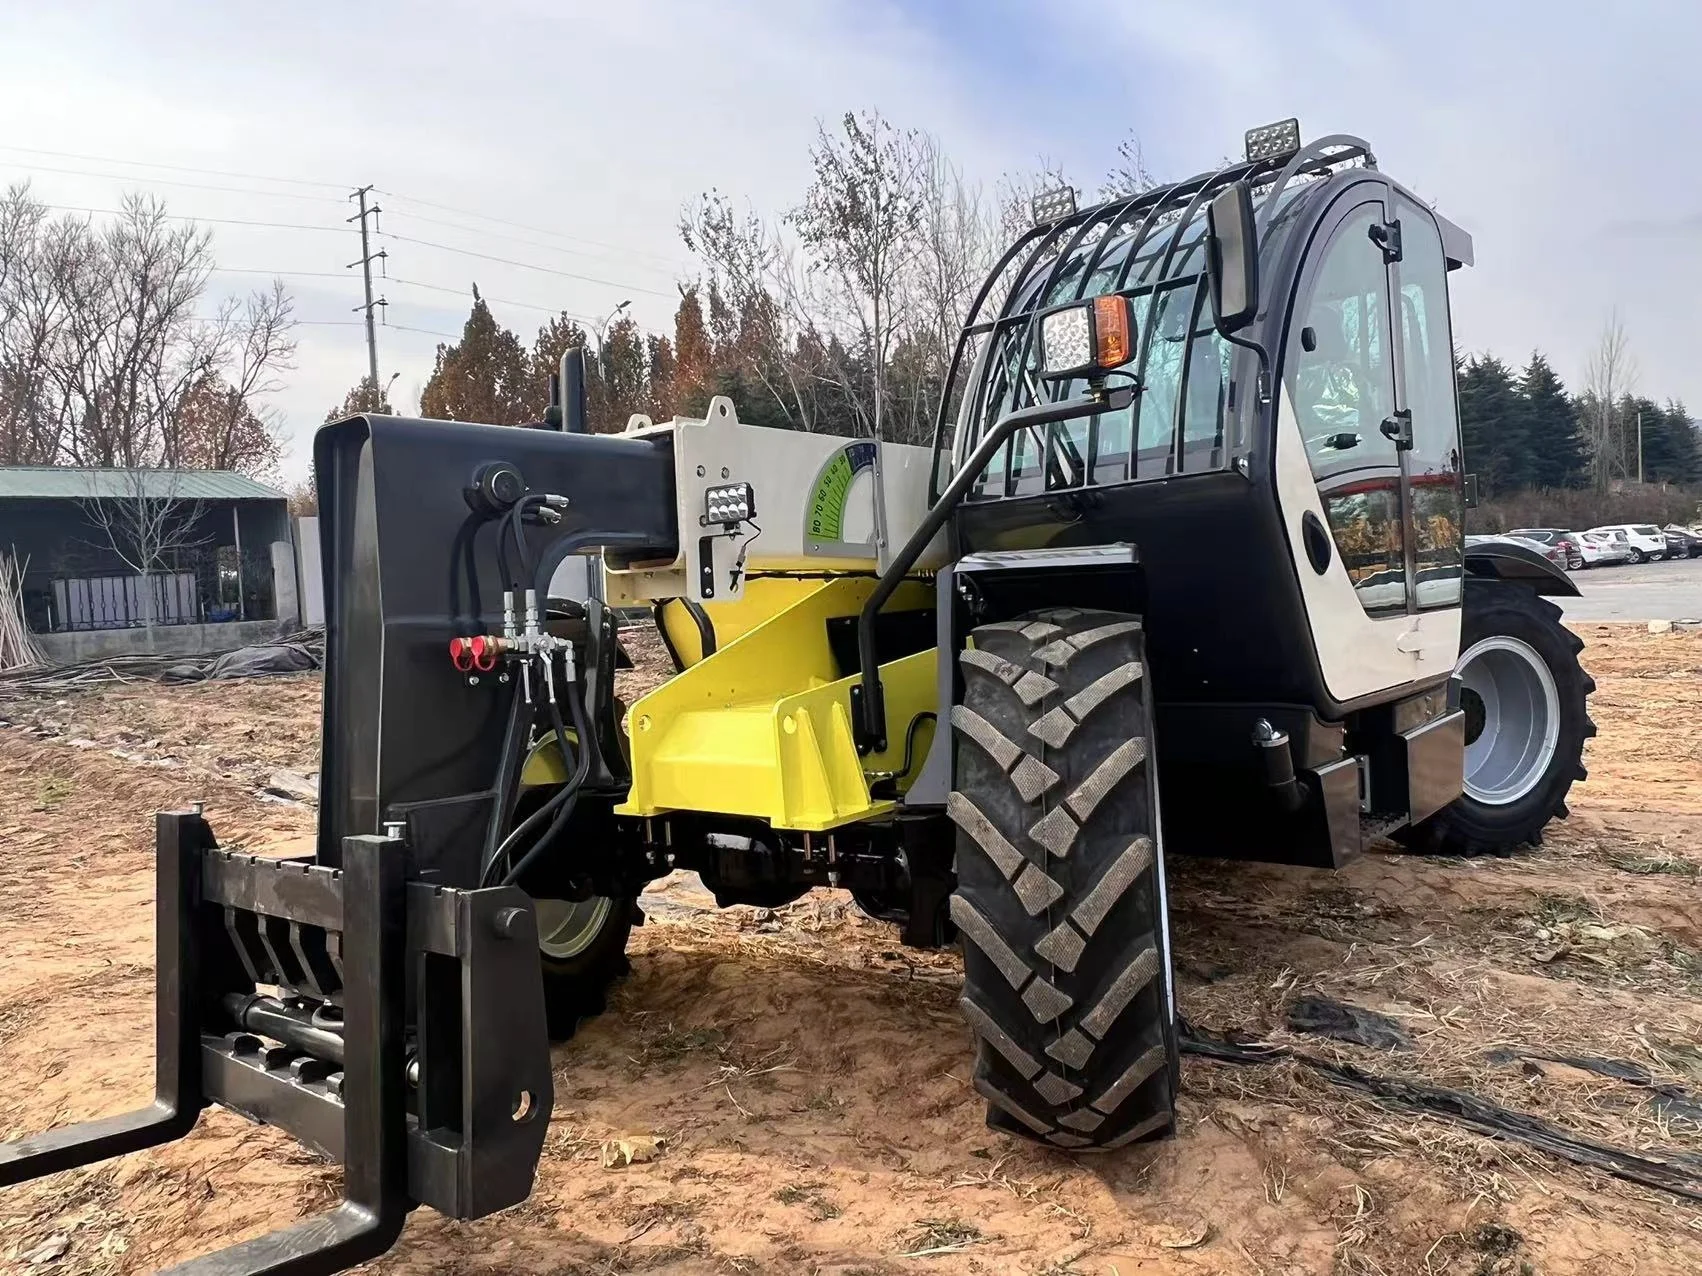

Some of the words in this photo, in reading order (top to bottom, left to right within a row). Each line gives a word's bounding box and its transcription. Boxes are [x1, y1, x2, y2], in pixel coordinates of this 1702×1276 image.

[824, 475, 832, 487] 50
[818, 489, 826, 502] 60
[814, 504, 823, 517] 70
[813, 519, 821, 533] 80
